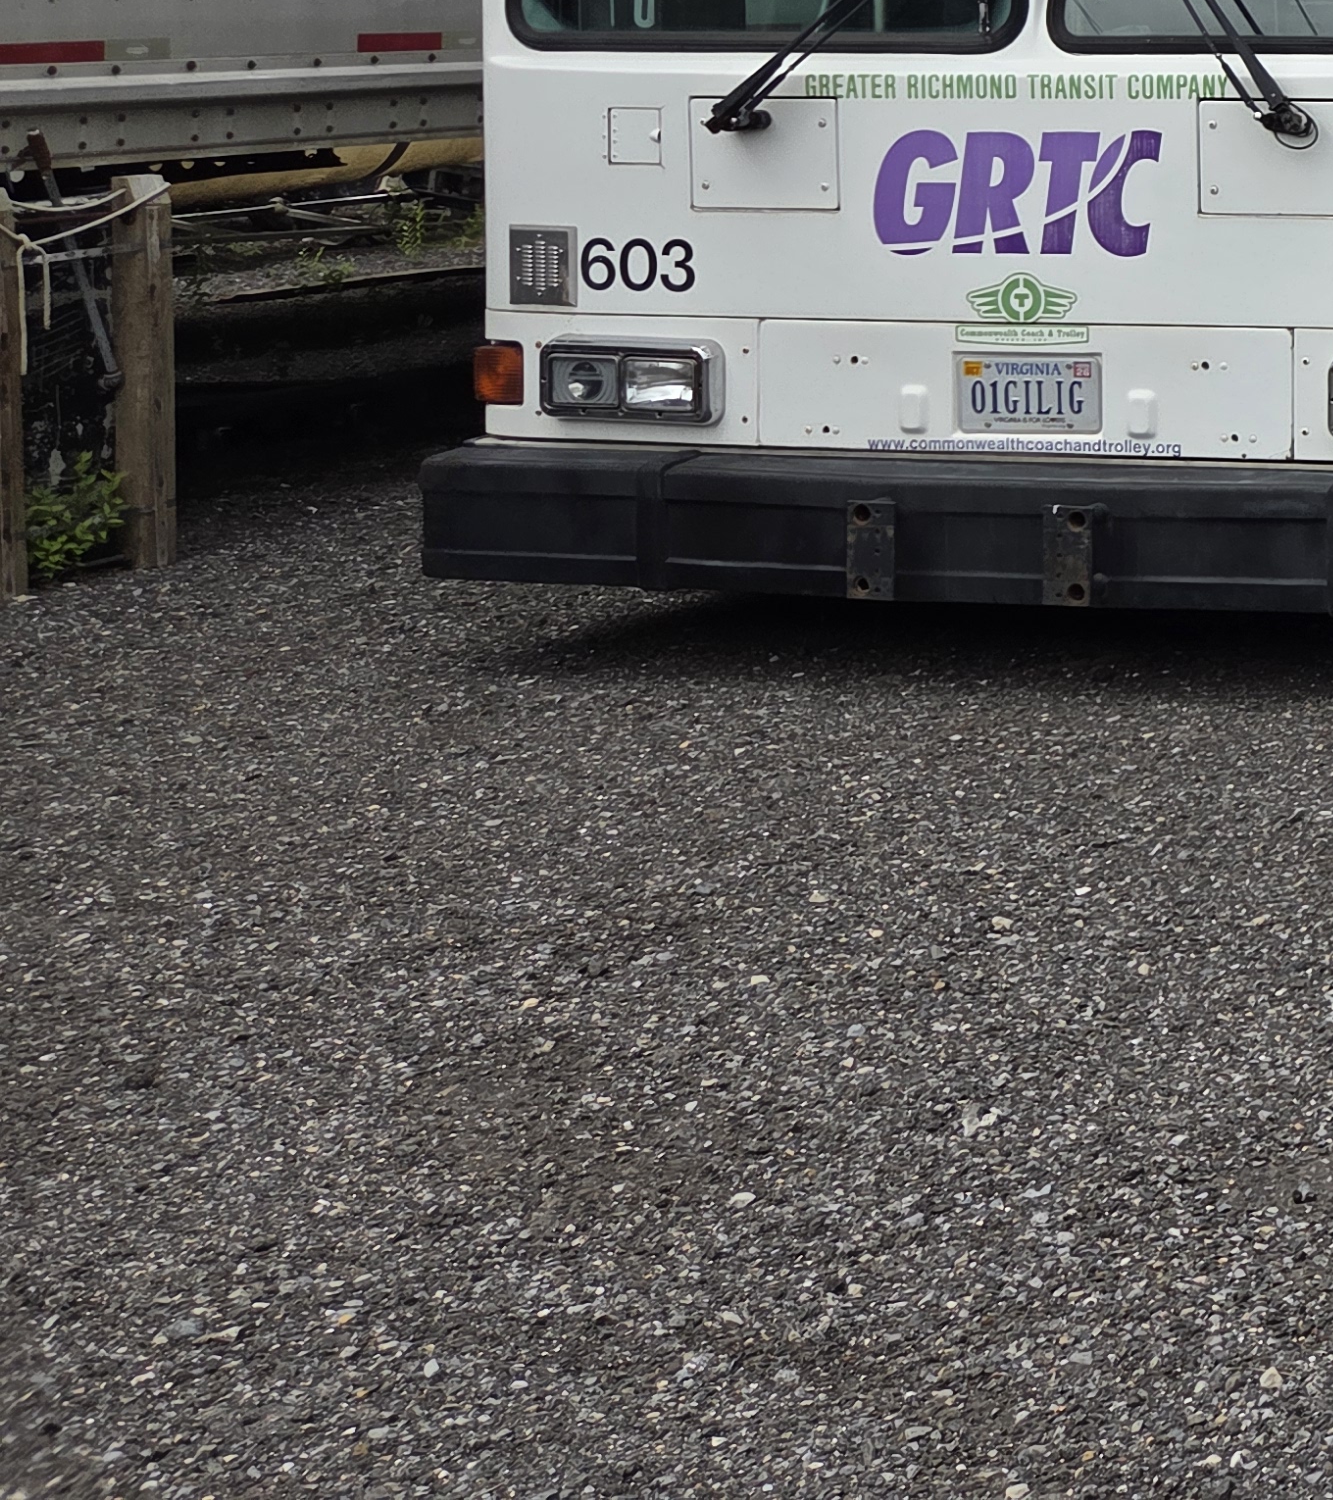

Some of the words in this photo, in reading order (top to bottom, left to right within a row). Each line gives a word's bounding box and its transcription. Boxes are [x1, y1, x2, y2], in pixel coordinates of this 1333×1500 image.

[804, 74, 897, 100] GREATER
[907, 74, 1018, 100] RICHMOND
[1026, 74, 1119, 100] TRANSIT
[1126, 74, 1229, 100] COMPANY
[873, 129, 1163, 258] GRTC
[580, 237, 696, 293] 603
[1021, 329, 1045, 338] Coach
[1056, 329, 1085, 339] Trolley
[994, 363, 1062, 376] VIRGINIA
[867, 438, 1182, 457] www.commonwealthcoachandtrolley.org
